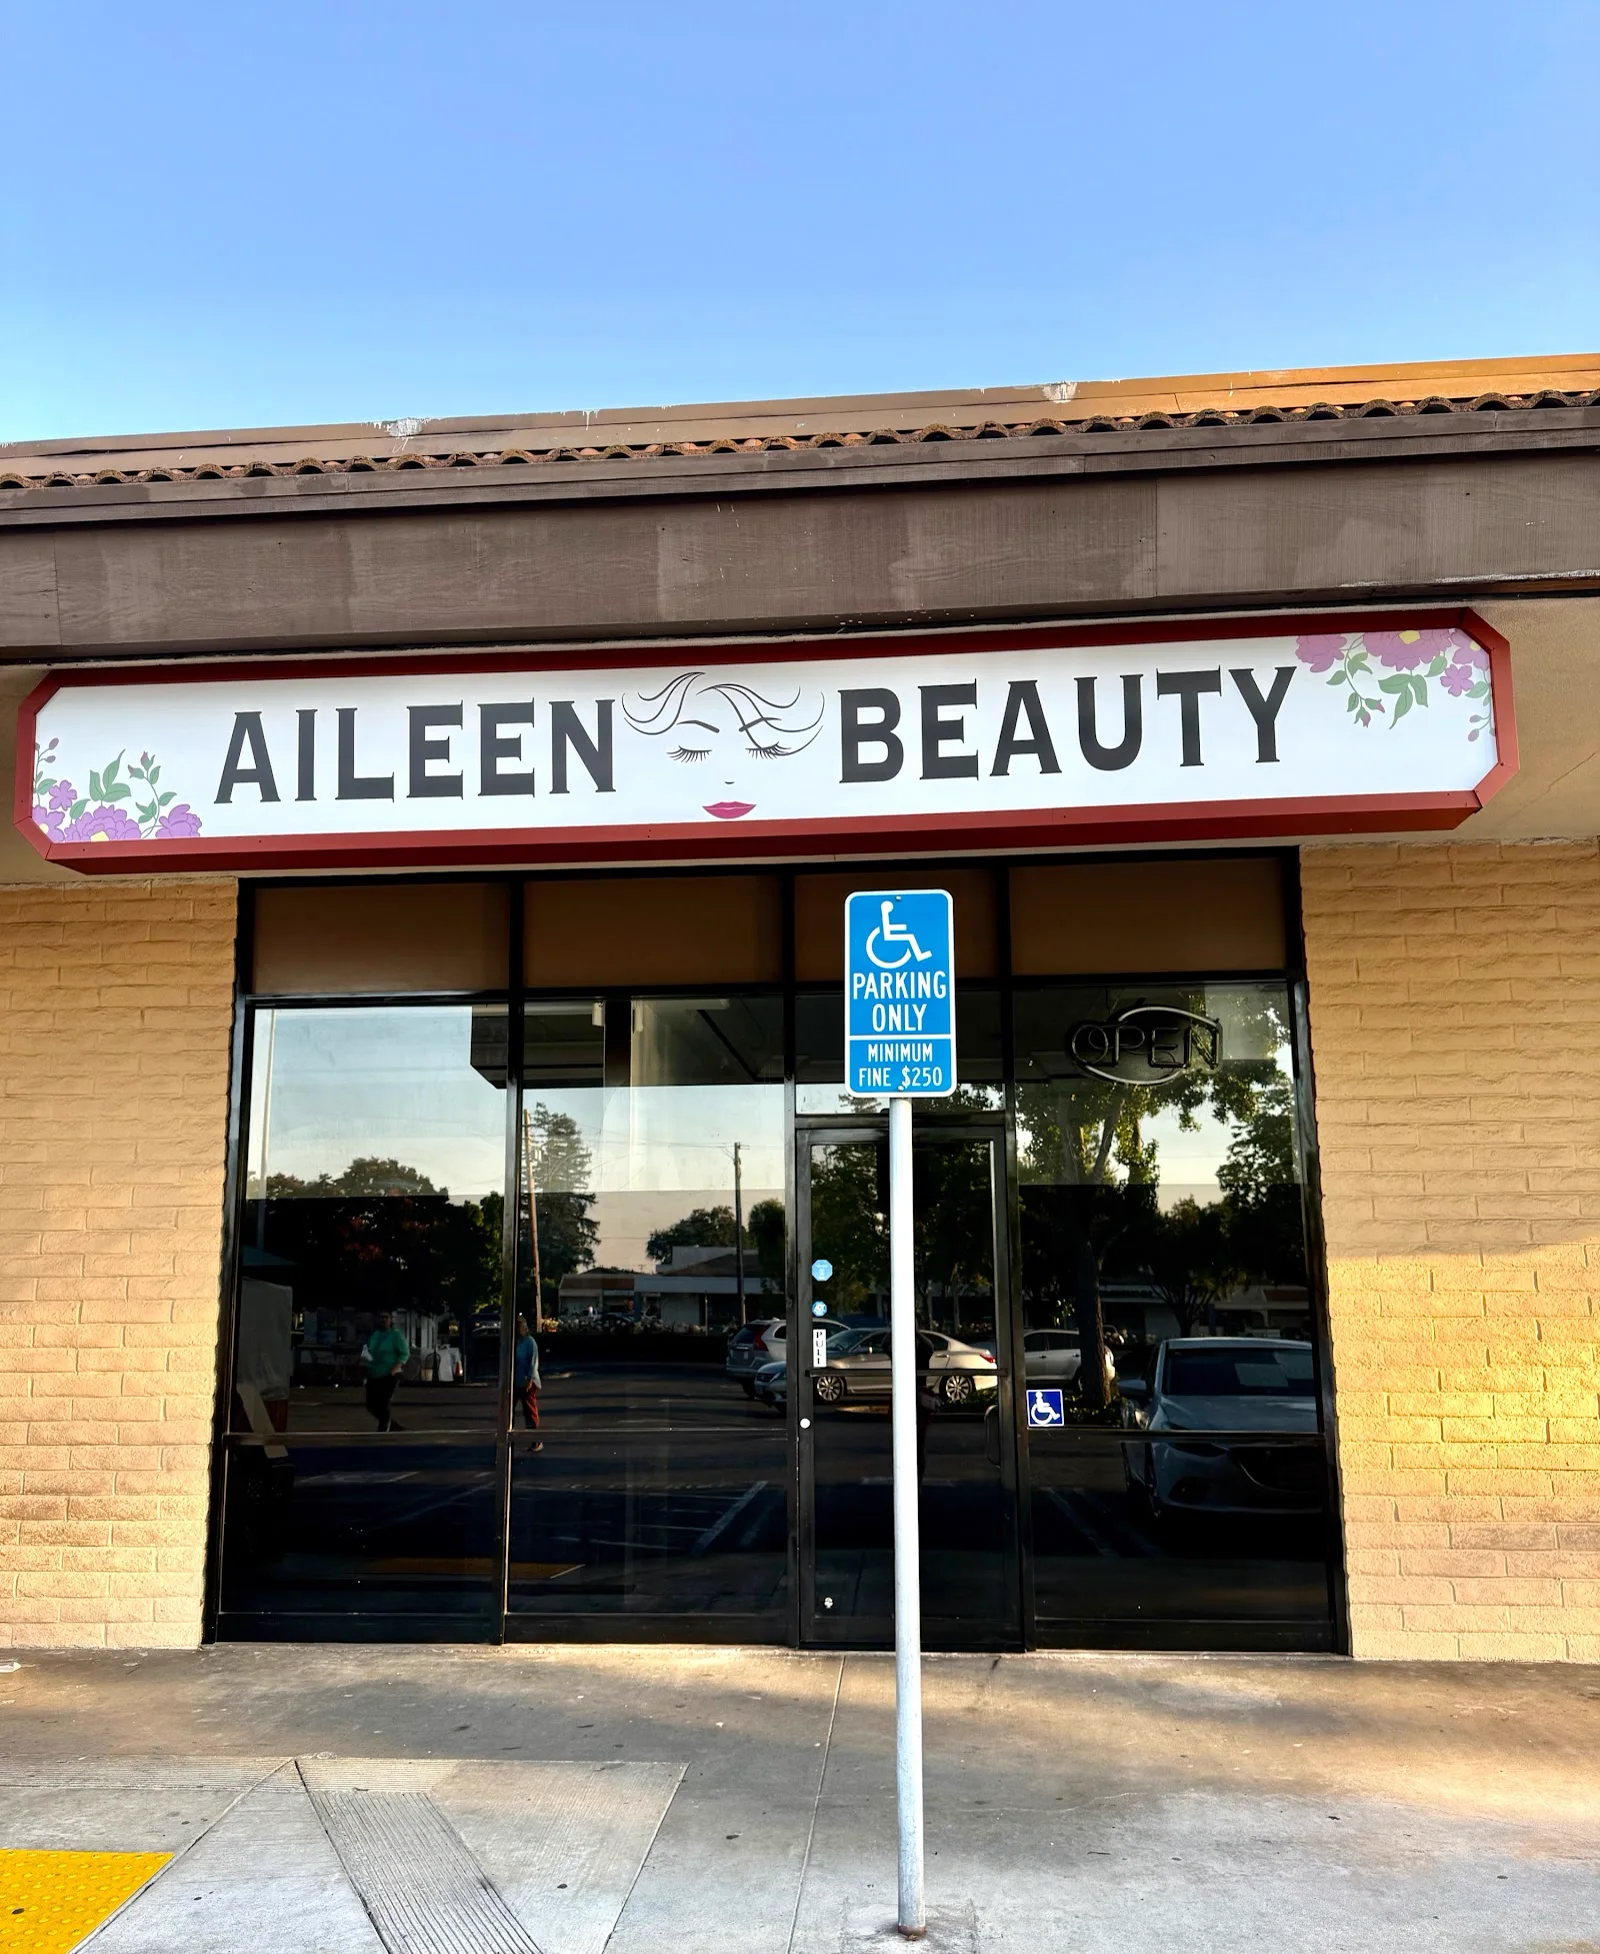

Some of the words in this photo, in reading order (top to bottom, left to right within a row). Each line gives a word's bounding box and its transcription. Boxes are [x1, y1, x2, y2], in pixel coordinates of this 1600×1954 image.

[214, 698, 616, 804] AILEEN
[839, 665, 1297, 784] BEAUTY
[853, 971, 947, 1000] PARKING
[872, 1003, 927, 1032] ONLY
[868, 1043, 933, 1062] MINIMUM
[1072, 1024, 1220, 1069] OPEN
[859, 1067, 891, 1087] FINE
[901, 1065, 943, 1089] $250
[815, 1331, 824, 1365] PULL
